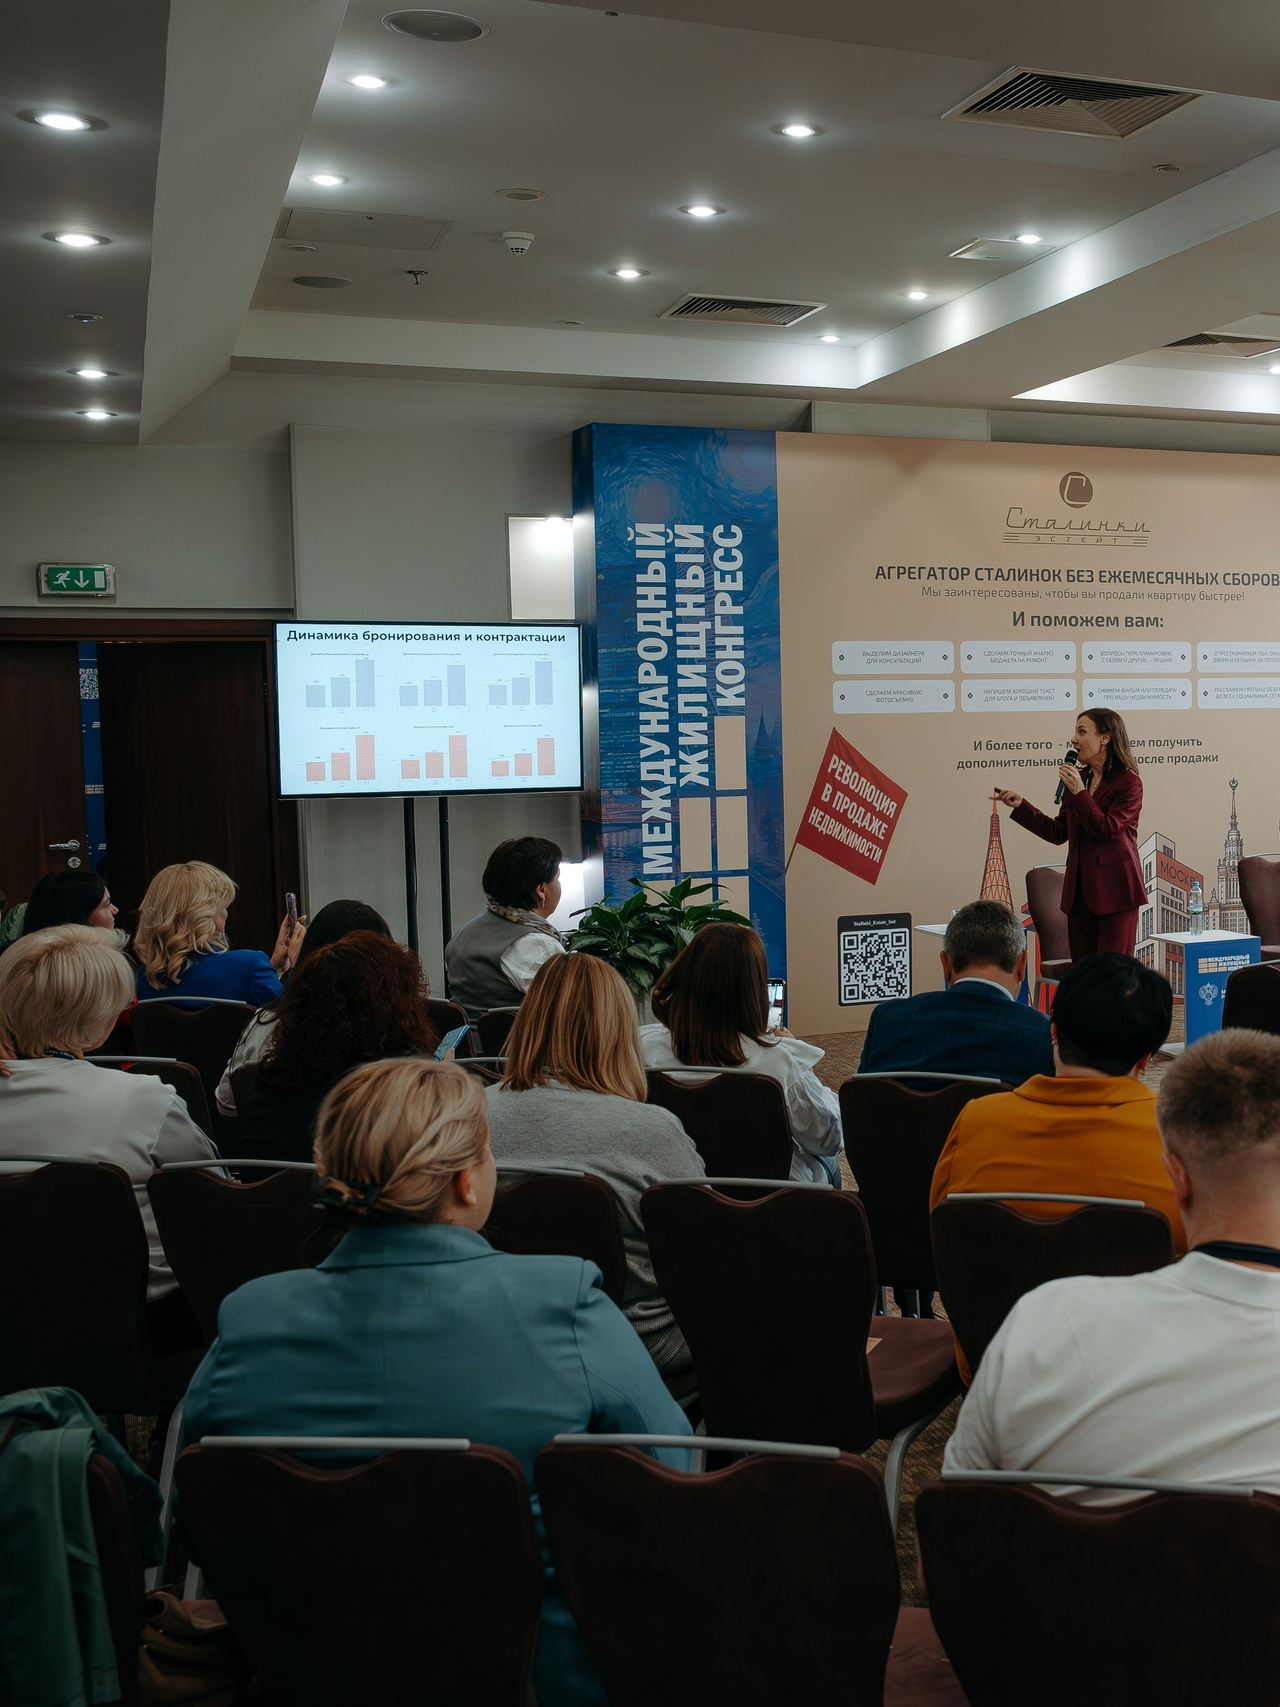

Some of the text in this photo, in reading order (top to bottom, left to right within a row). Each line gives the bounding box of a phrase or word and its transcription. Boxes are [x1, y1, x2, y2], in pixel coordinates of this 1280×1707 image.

[1006, 507, 1151, 533] Сталинки
[875, 566, 970, 581] АГРЕГАТОР
[974, 567, 1061, 582] СТАЛИНОК
[1066, 569, 1094, 583] БЕЗ
[1099, 570, 1219, 585] ЕЖЕМЕСЯЧНЫХ
[921, 587, 1245, 603] Мы заинтересованы, чтобы вы продали квартиру быстрее!
[713, 524, 746, 706] КОНГРЕСС
[1012, 611, 1164, 628] И поможем вам:
[287, 630, 565, 643] Динамика бронирования и контрактации
[666, 525, 711, 787] ЖИЛИЩНЫЙ
[892, 649, 925, 657] ДИЗАЙНЕРА
[627, 523, 677, 875] МЕЖДУНАРОДНЫЙ
[973, 740, 983, 751] И
[985, 739, 1022, 751] более
[1025, 741, 1052, 750] того
[1149, 737, 1202, 749] получить
[957, 758, 1064, 770] дополнительные
[1168, 754, 1219, 765] продажи
[827, 754, 897, 818] РЕВОЛЮЦИЯ
[821, 783, 888, 840] В ПРОДАЖЕ
[808, 806, 883, 863] НЕДВИЖИМОСТИ
[1160, 860, 1196, 887] МОСКВ
